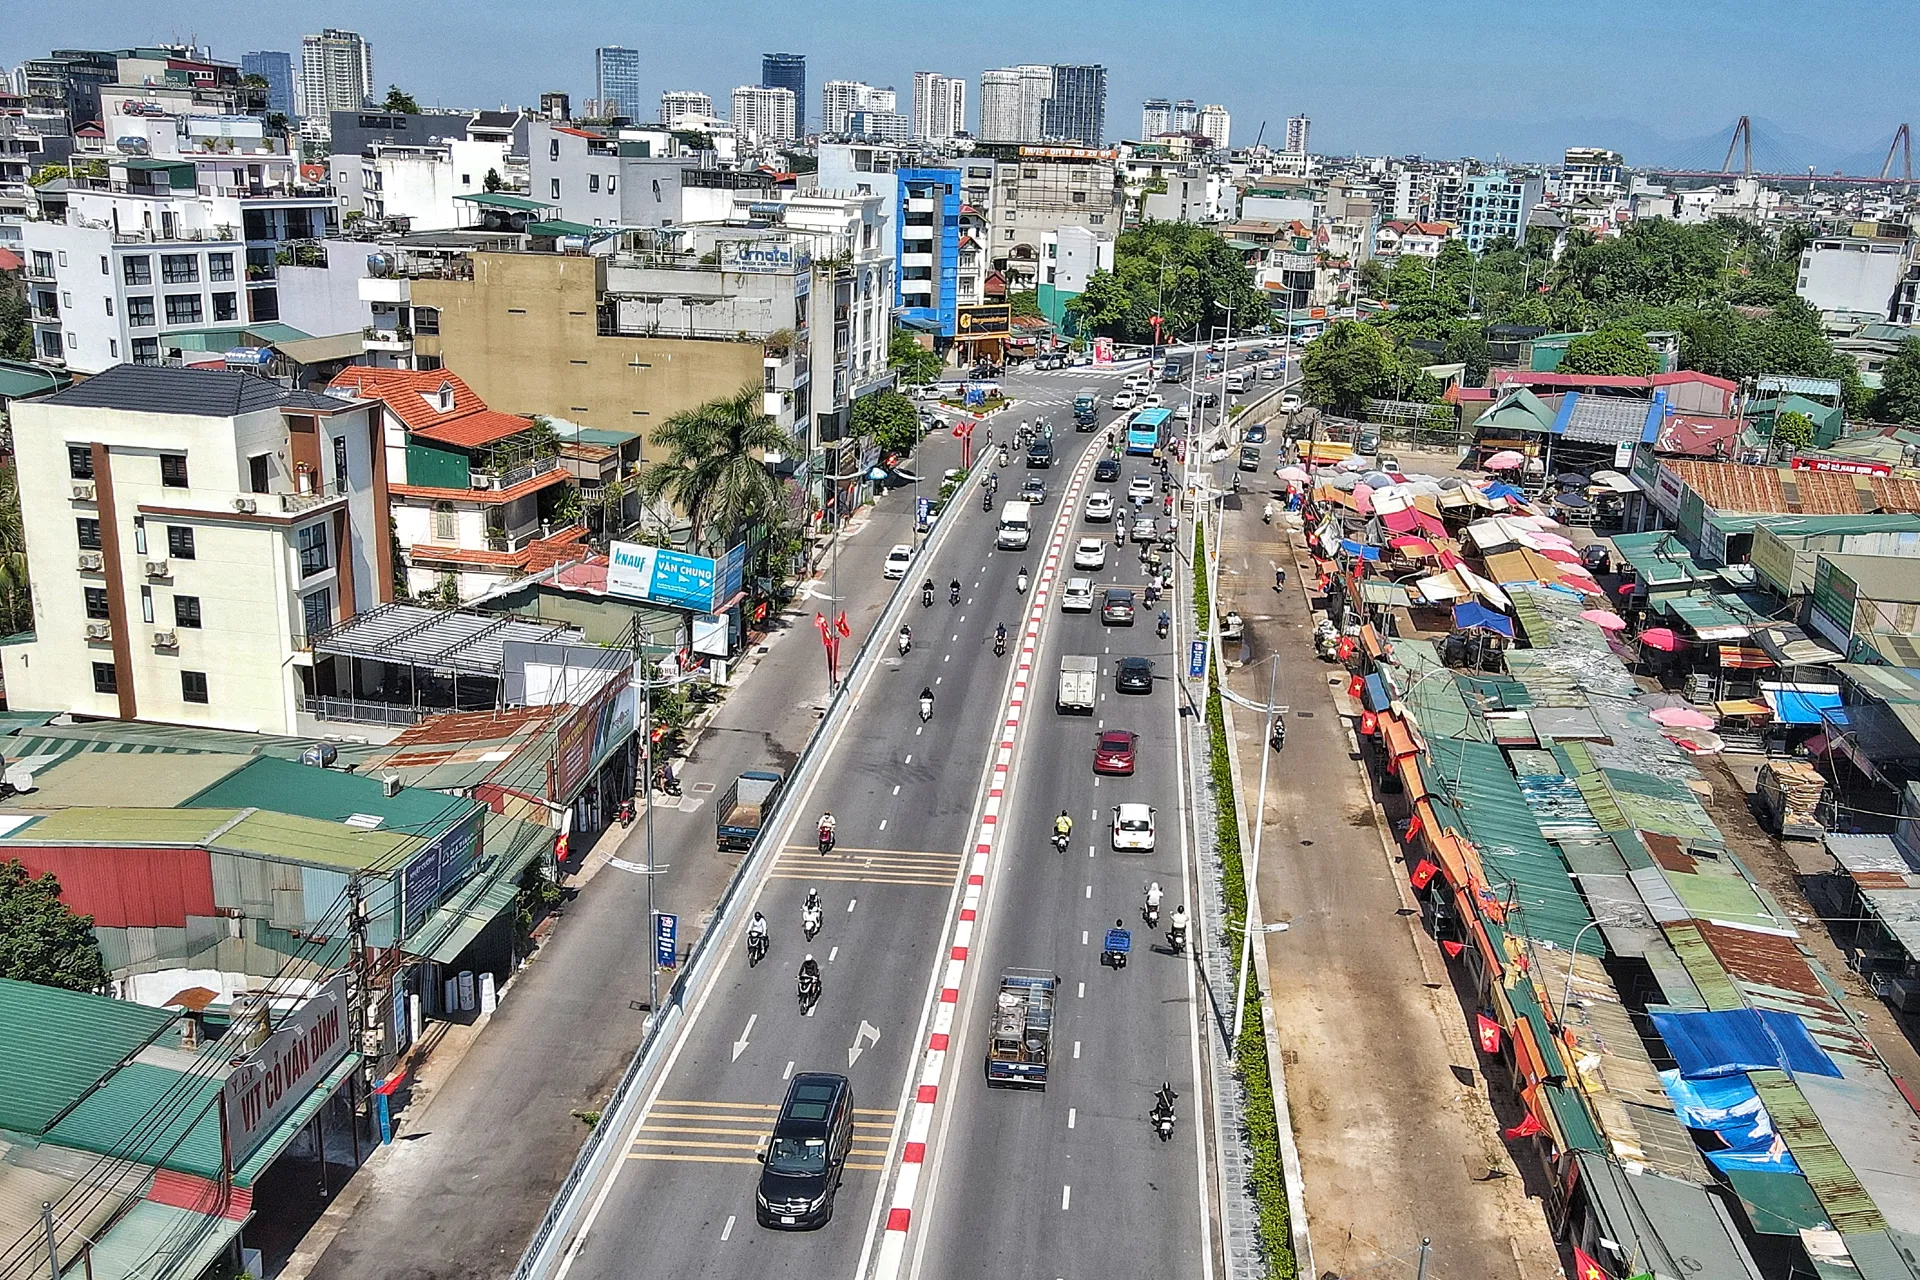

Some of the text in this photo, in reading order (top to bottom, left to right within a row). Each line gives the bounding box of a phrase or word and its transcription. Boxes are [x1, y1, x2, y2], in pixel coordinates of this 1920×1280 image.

[679, 566, 712, 580] CHUNG
[240, 1080, 262, 1133] VỊT
[265, 1051, 282, 1109] CỎ
[283, 1037, 310, 1090] VÂN
[310, 1005, 340, 1063] ĐÌNH
